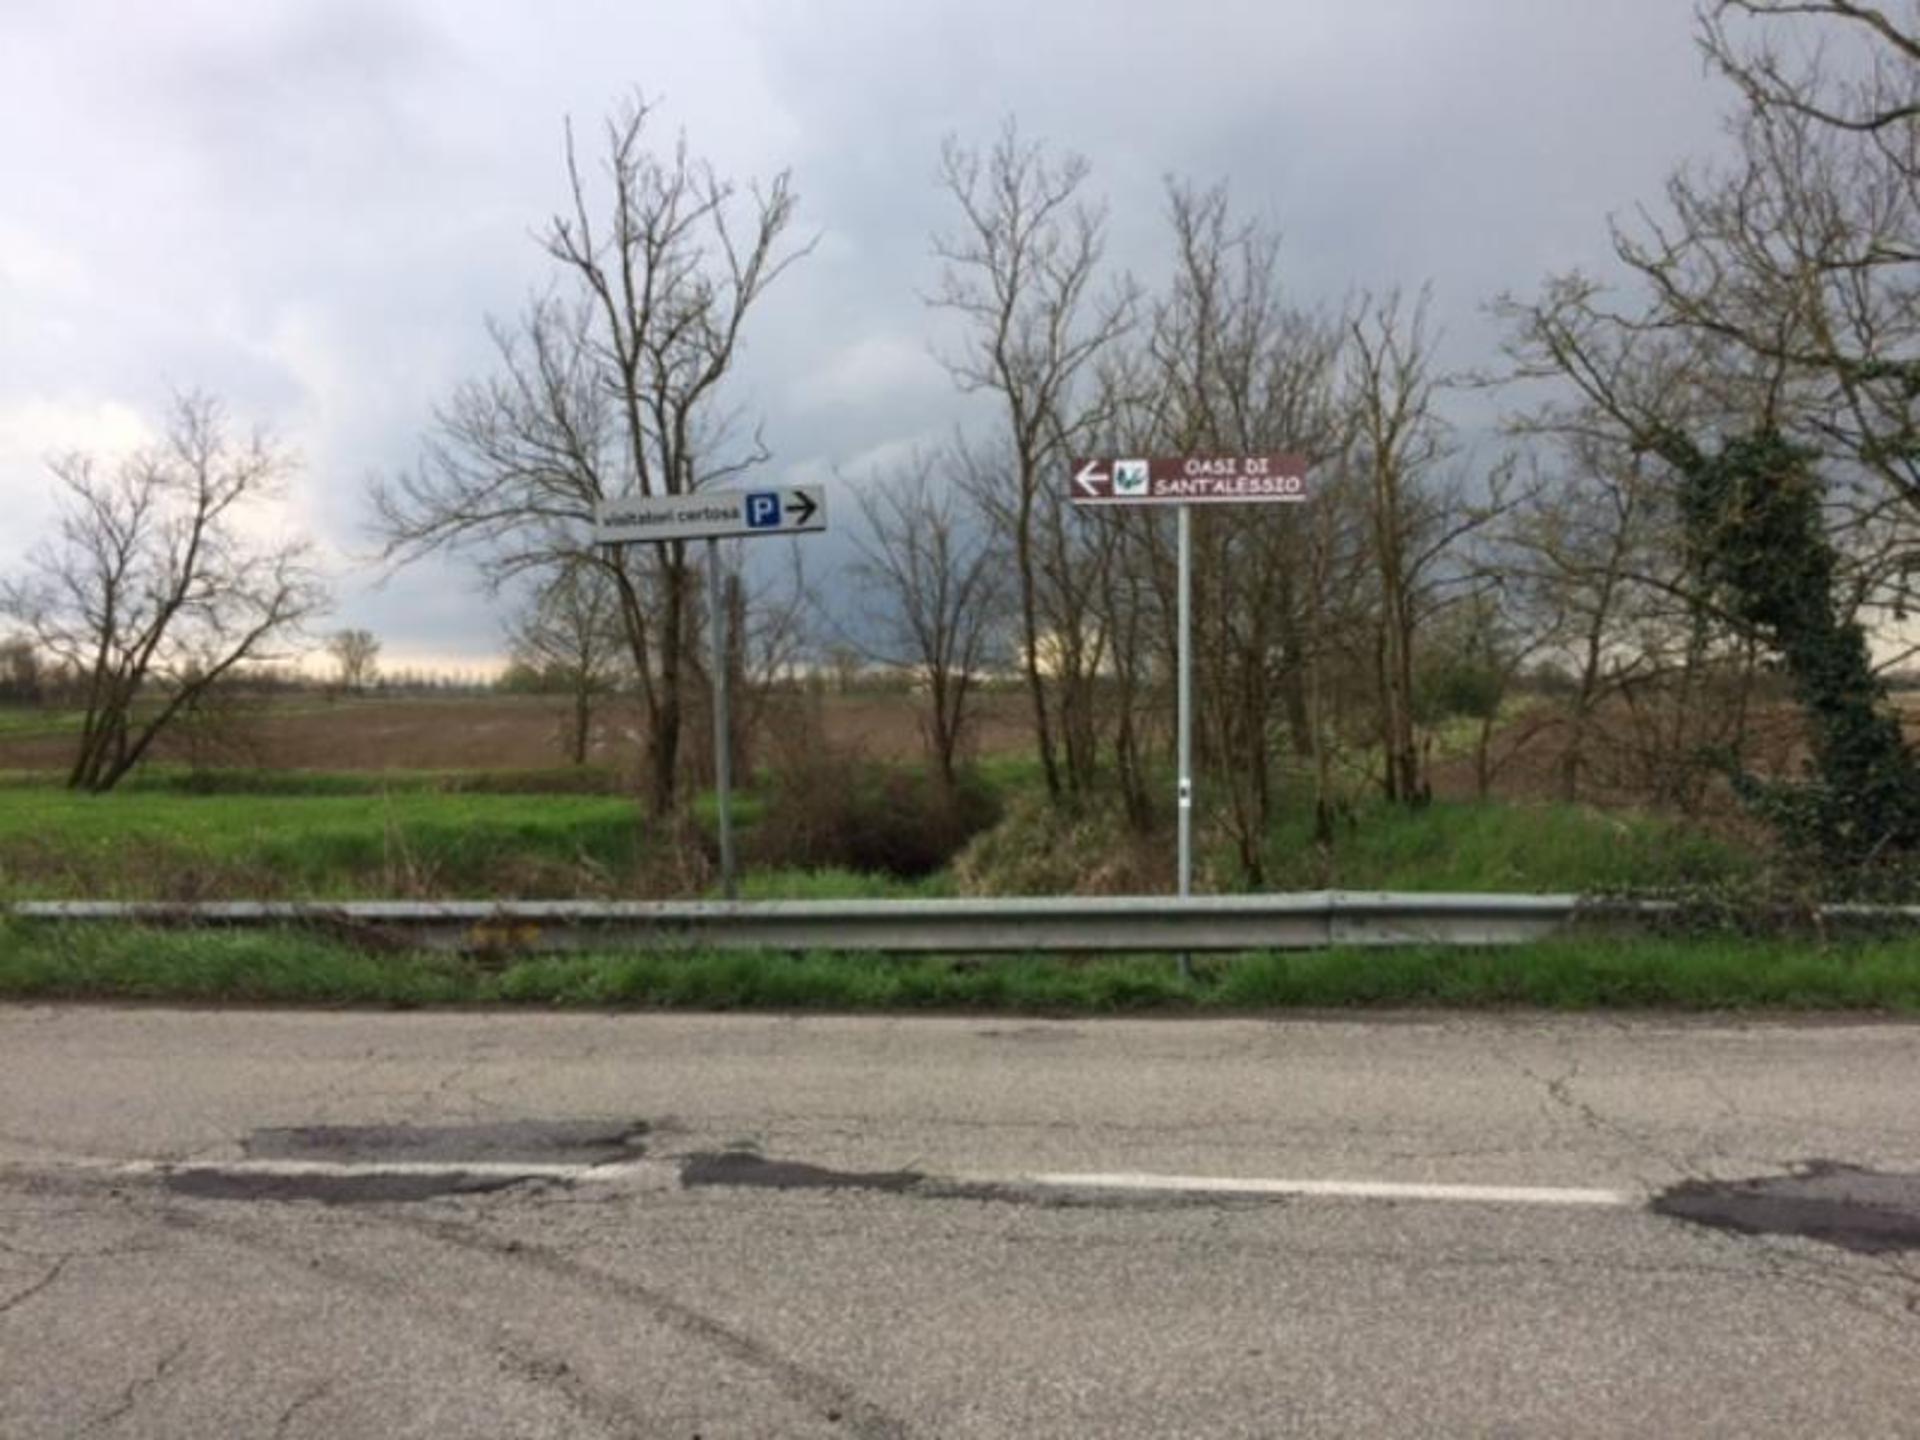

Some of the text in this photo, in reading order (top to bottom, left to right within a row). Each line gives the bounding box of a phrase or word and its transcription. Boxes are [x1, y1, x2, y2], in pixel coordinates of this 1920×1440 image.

[1185, 458, 1269, 475] OASI DI
[1154, 477, 1300, 495] SANT'ALESSIO
[678, 505, 740, 523] certosa
[754, 499, 773, 523] P
